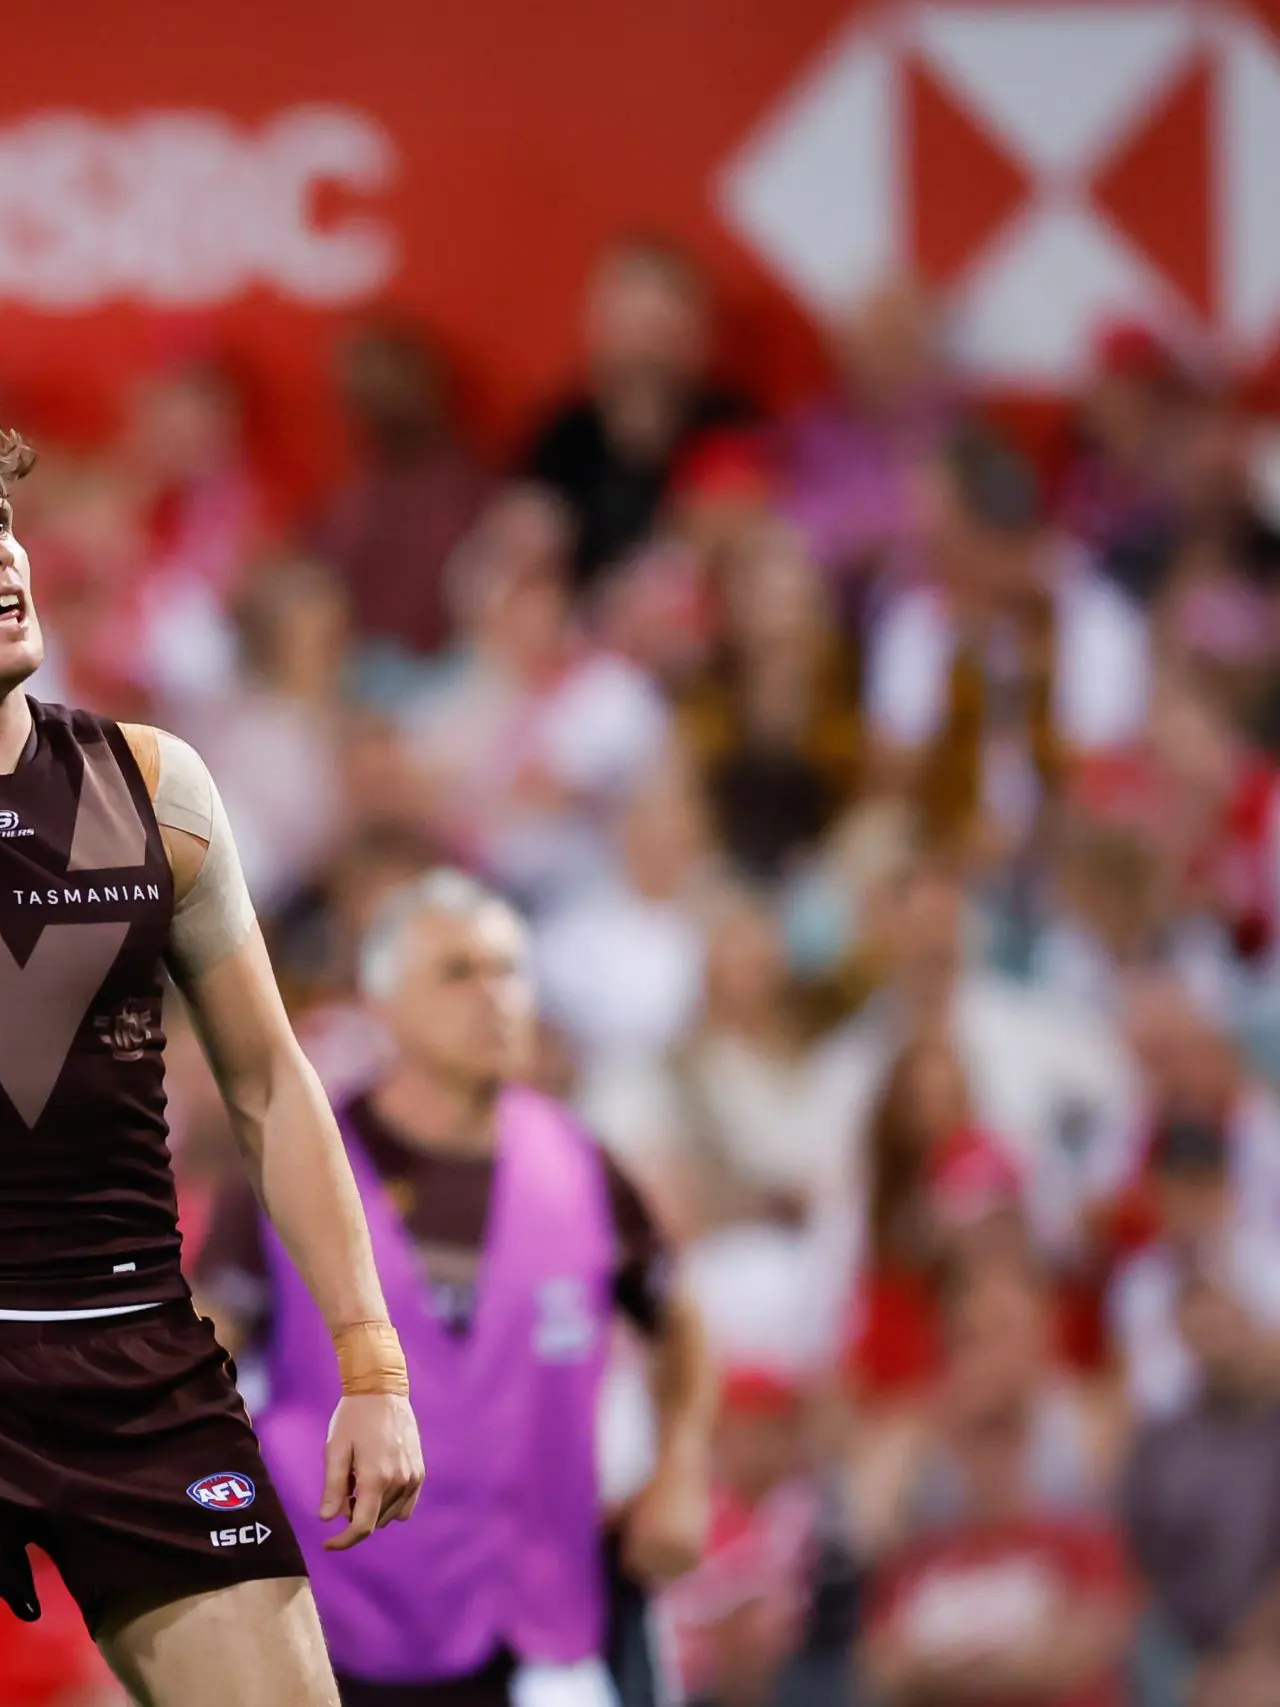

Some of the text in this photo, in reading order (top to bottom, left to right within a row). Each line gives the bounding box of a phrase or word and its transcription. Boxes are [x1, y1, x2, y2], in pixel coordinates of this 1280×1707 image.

[13, 884, 160, 905] TASMANIAN
[198, 1479, 252, 1503] AFL
[210, 1525, 255, 1547] ISC
